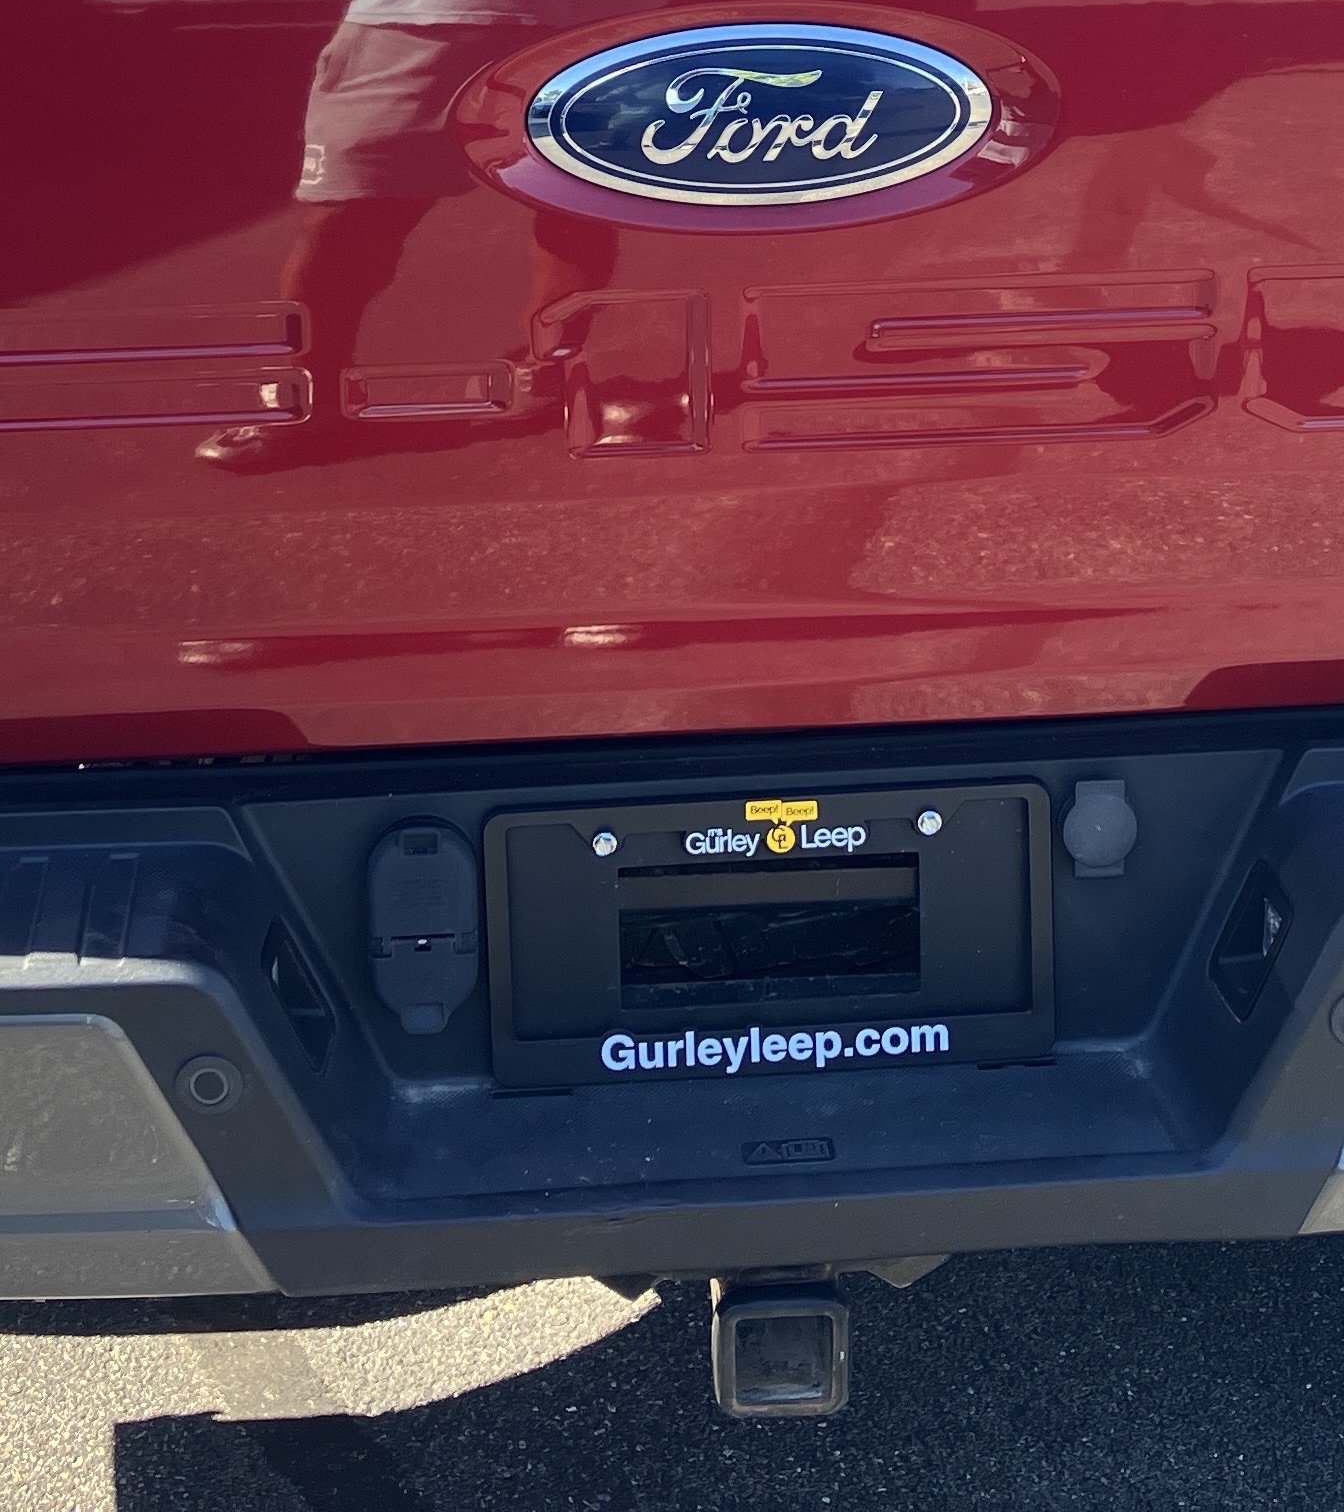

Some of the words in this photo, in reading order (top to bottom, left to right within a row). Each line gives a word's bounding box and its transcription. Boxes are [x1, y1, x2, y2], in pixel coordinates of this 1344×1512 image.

[641, 67, 884, 165] Ford
[750, 804, 778, 816] Beep!
[786, 806, 814, 817] Beep!
[685, 828, 760, 857] Gurley
[801, 824, 866, 852] Leep
[601, 1020, 949, 1075] Gurleyleep.com
